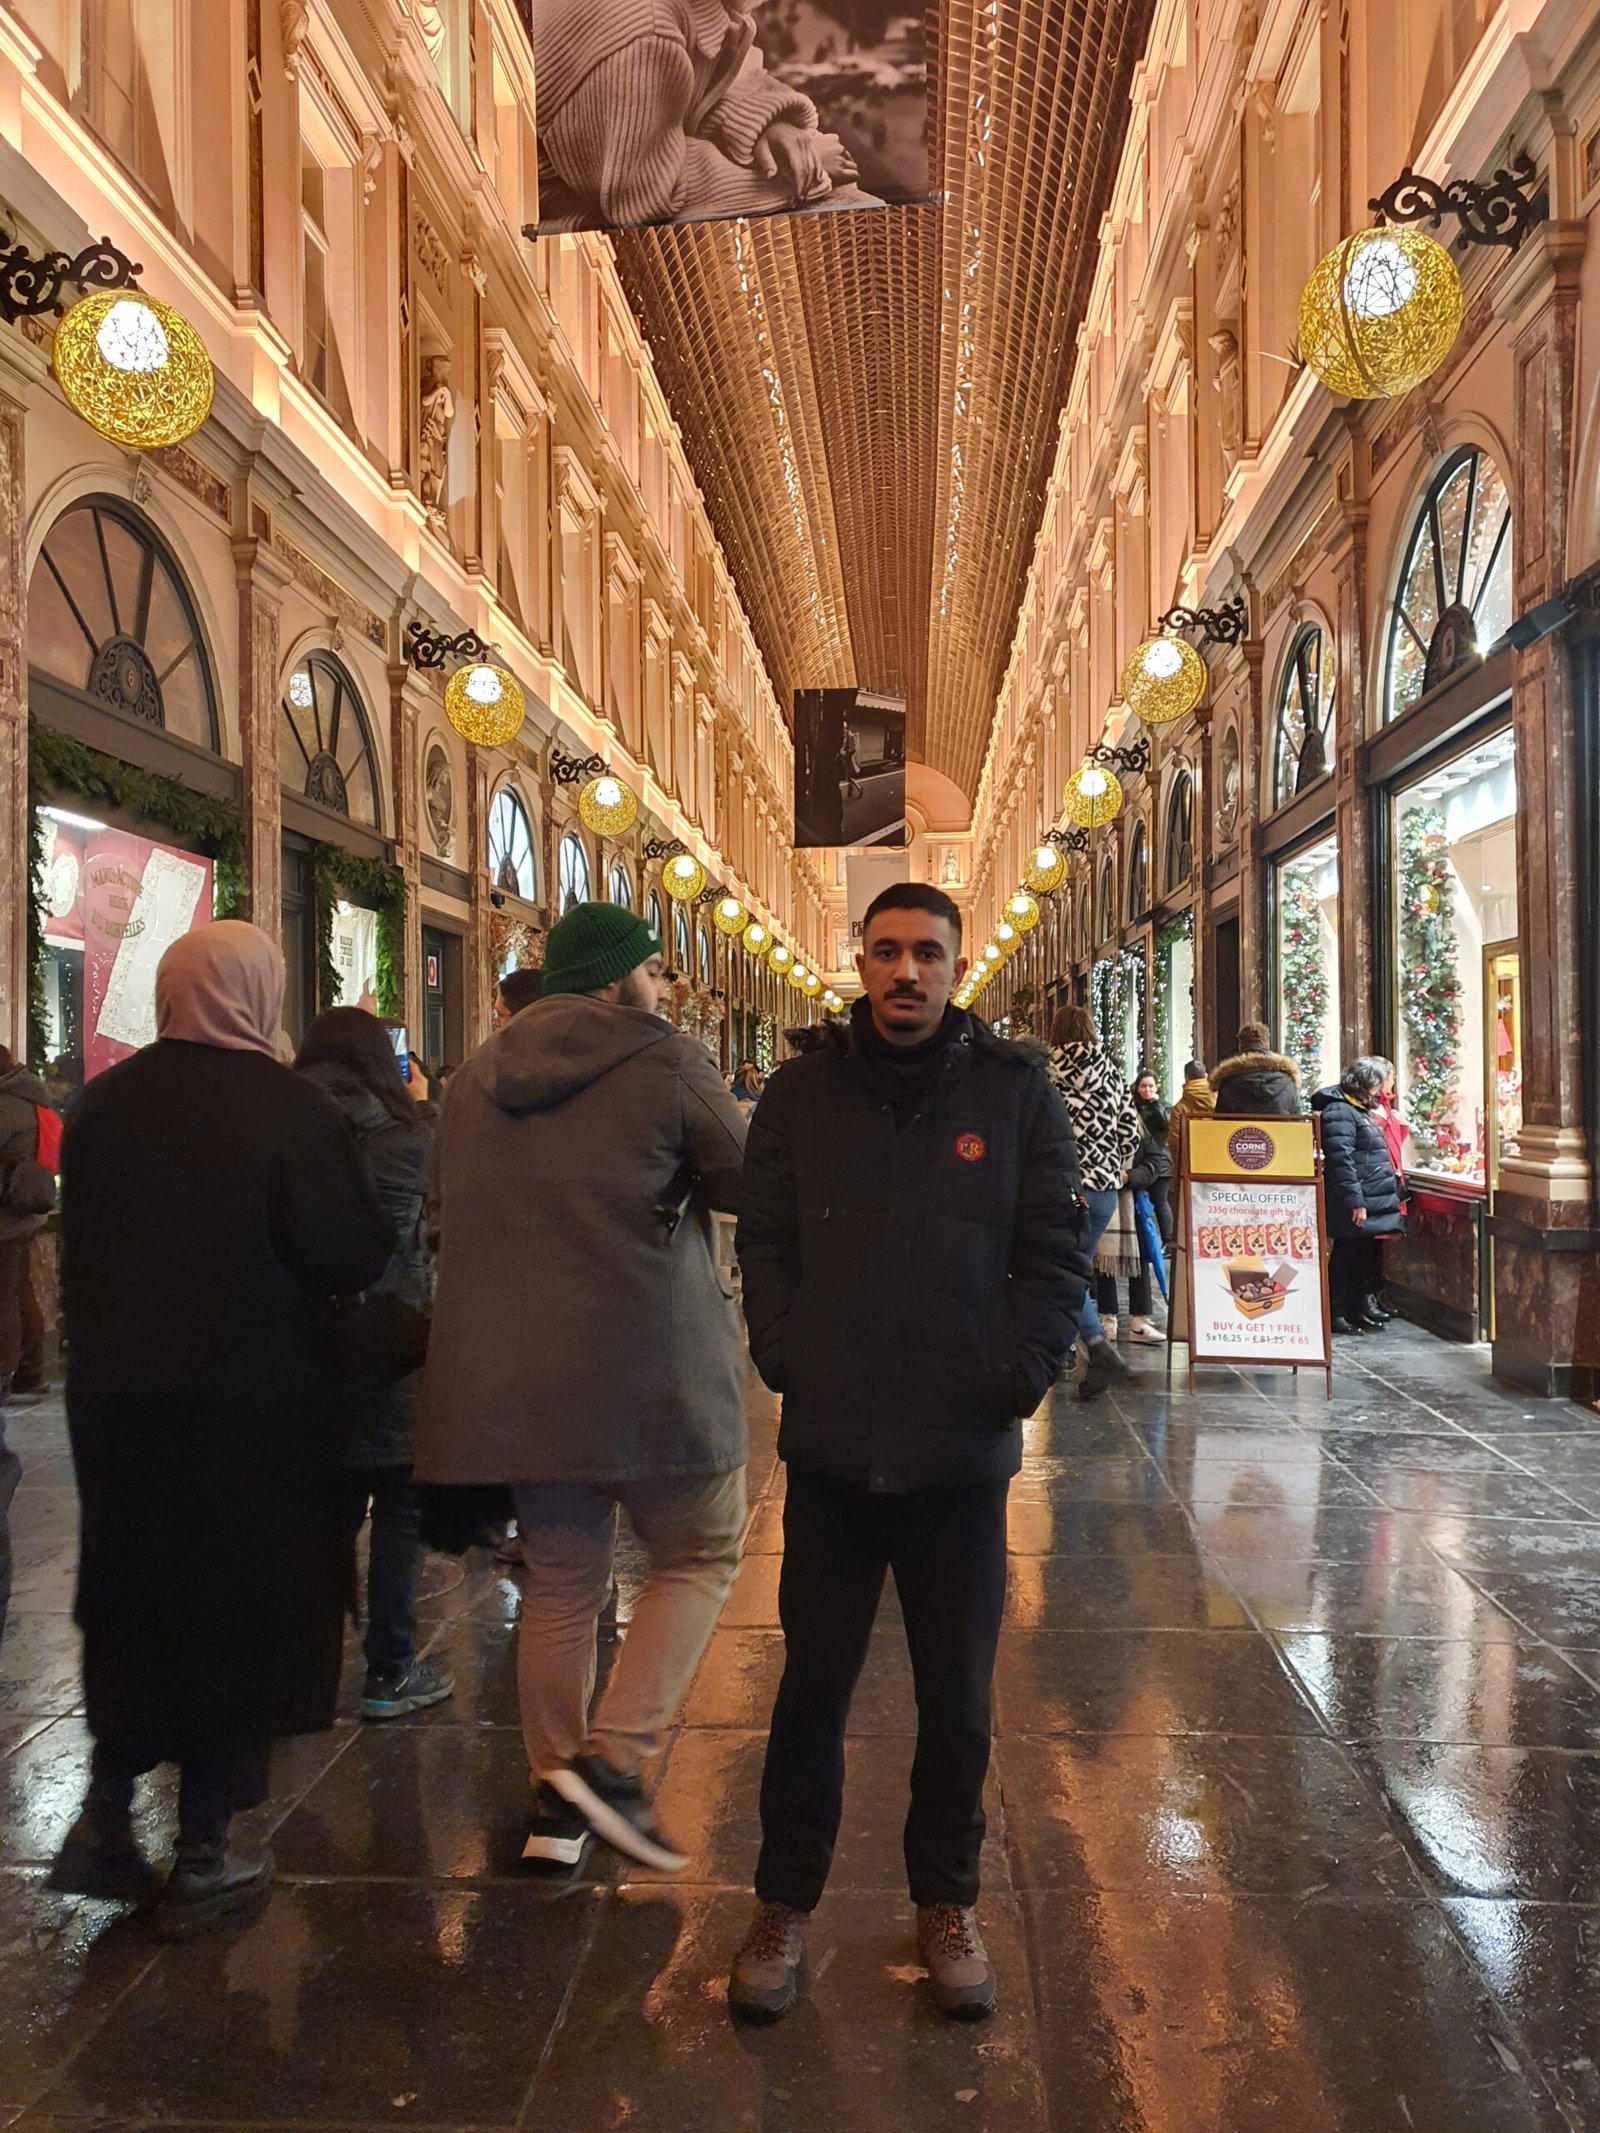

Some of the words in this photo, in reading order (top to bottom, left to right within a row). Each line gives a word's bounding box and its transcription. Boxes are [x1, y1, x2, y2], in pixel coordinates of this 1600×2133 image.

[1235, 1142, 1267, 1151] CORNÉ
[1211, 1192, 1256, 1203] SPECIAL
[1258, 1193, 1297, 1205] OFFER!
[1208, 1206, 1228, 1215] 235g
[1229, 1206, 1269, 1216] chocolate
[1270, 1208, 1284, 1217] gift
[1213, 1321, 1235, 1331] BUY
[1236, 1323, 1243, 1331] 4
[1246, 1323, 1265, 1332] GET
[1277, 1324, 1303, 1334] FREE
[1298, 1337, 1310, 1345] 65
